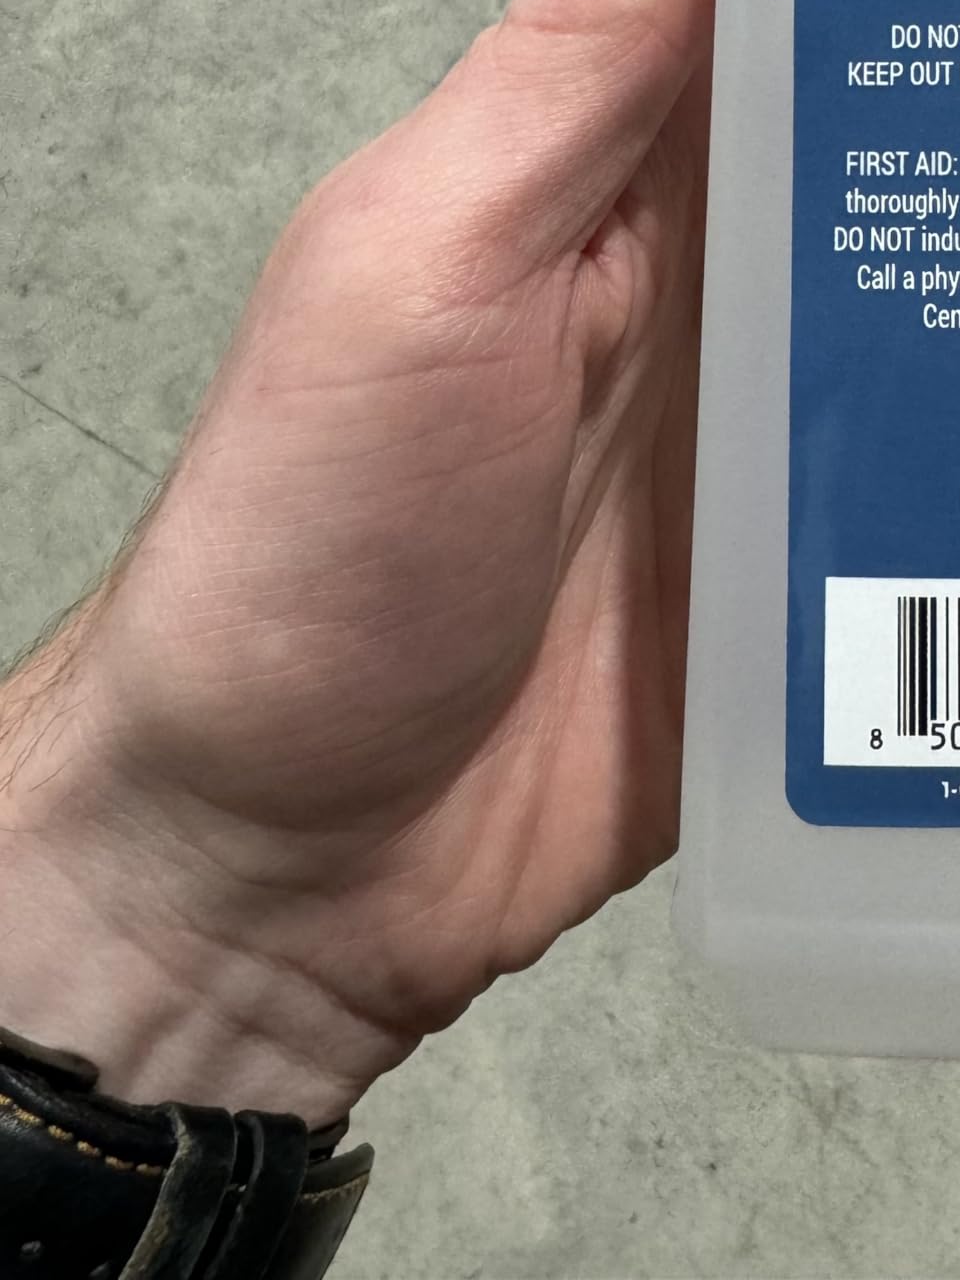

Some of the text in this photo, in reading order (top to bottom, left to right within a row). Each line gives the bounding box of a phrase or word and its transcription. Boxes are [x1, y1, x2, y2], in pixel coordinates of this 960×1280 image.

[891, 24, 921, 49] DO
[847, 61, 904, 87] KEEP
[909, 60, 955, 86] OUT
[846, 150, 910, 177] FIRST
[914, 150, 958, 177] AID:
[844, 187, 960, 221] thoroughly
[833, 225, 864, 252] DO
[870, 226, 916, 252] NOT
[857, 263, 896, 291] Call
[902, 270, 915, 290] a
[870, 728, 883, 750] 8
